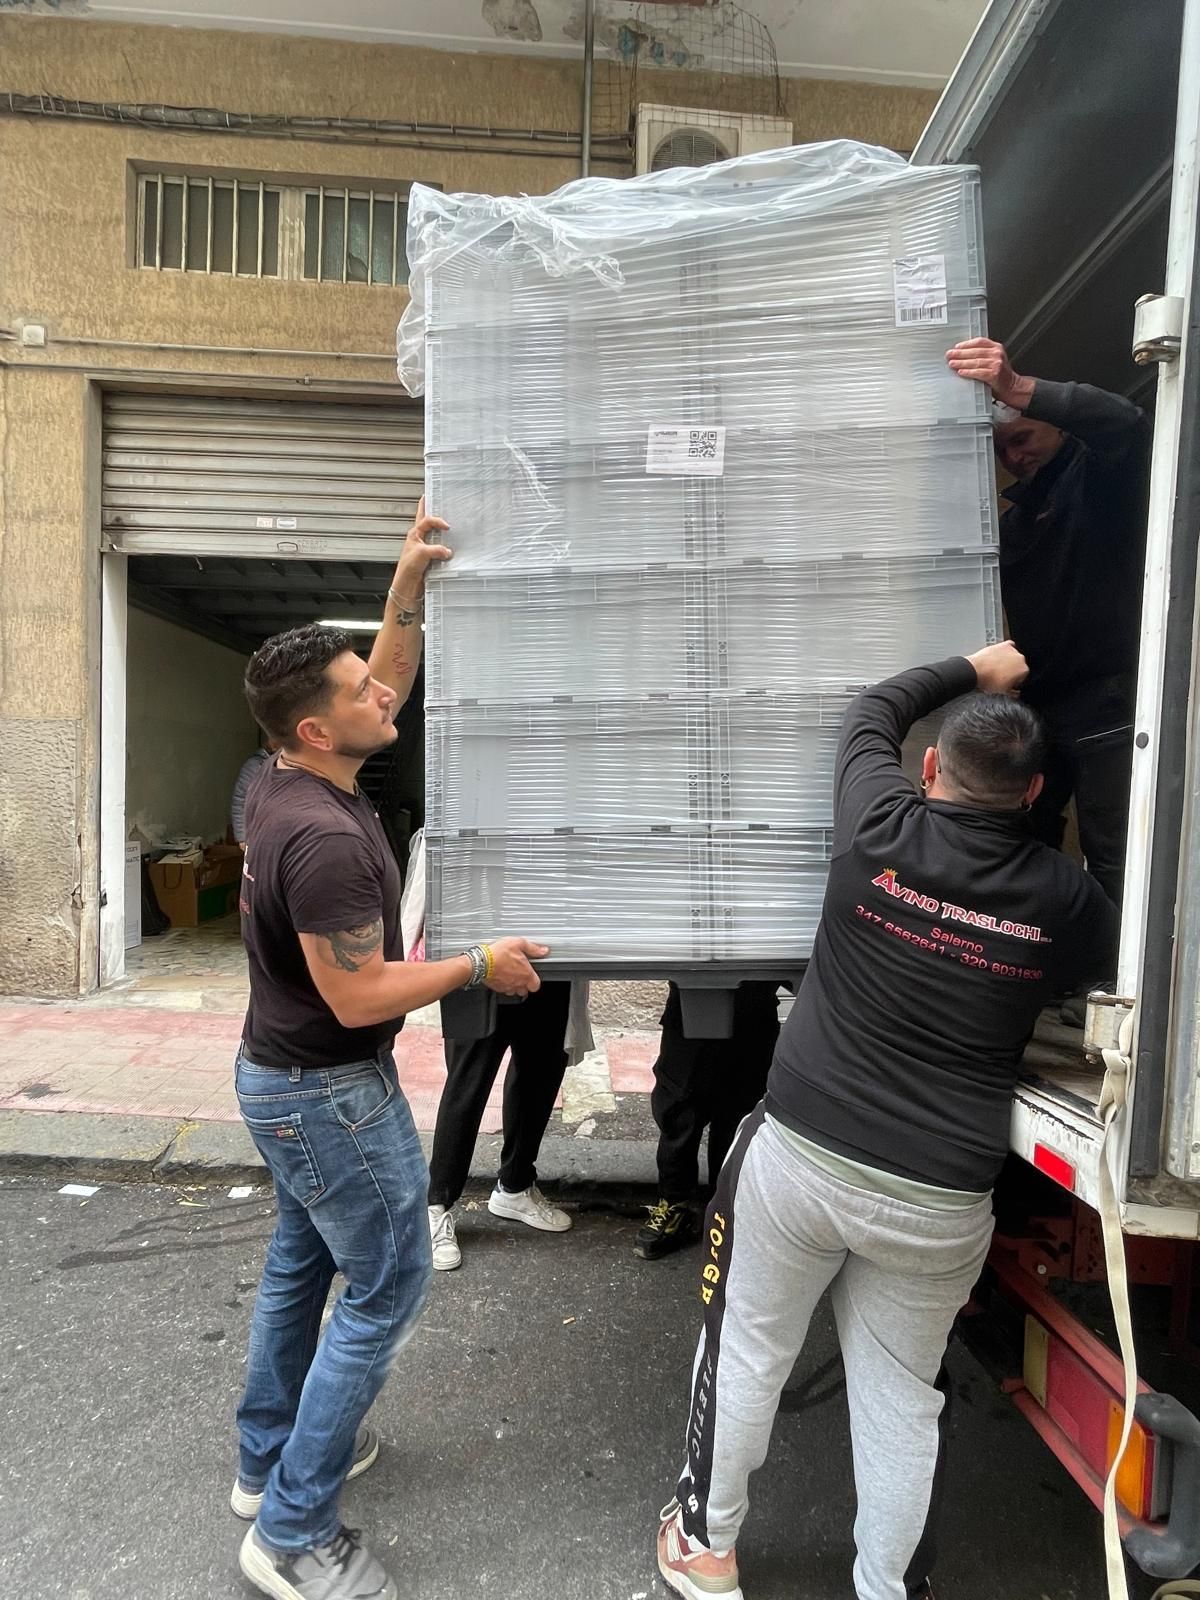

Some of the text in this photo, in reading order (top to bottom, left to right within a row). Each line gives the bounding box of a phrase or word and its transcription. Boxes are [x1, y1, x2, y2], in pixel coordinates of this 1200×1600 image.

[855, 905, 882, 923] 347
[884, 921, 945, 955] 6562641
[959, 953, 988, 969] 320
[871, 870, 1041, 942] AVINO TRASLOCHI
[930, 927, 984, 953] Salerno
